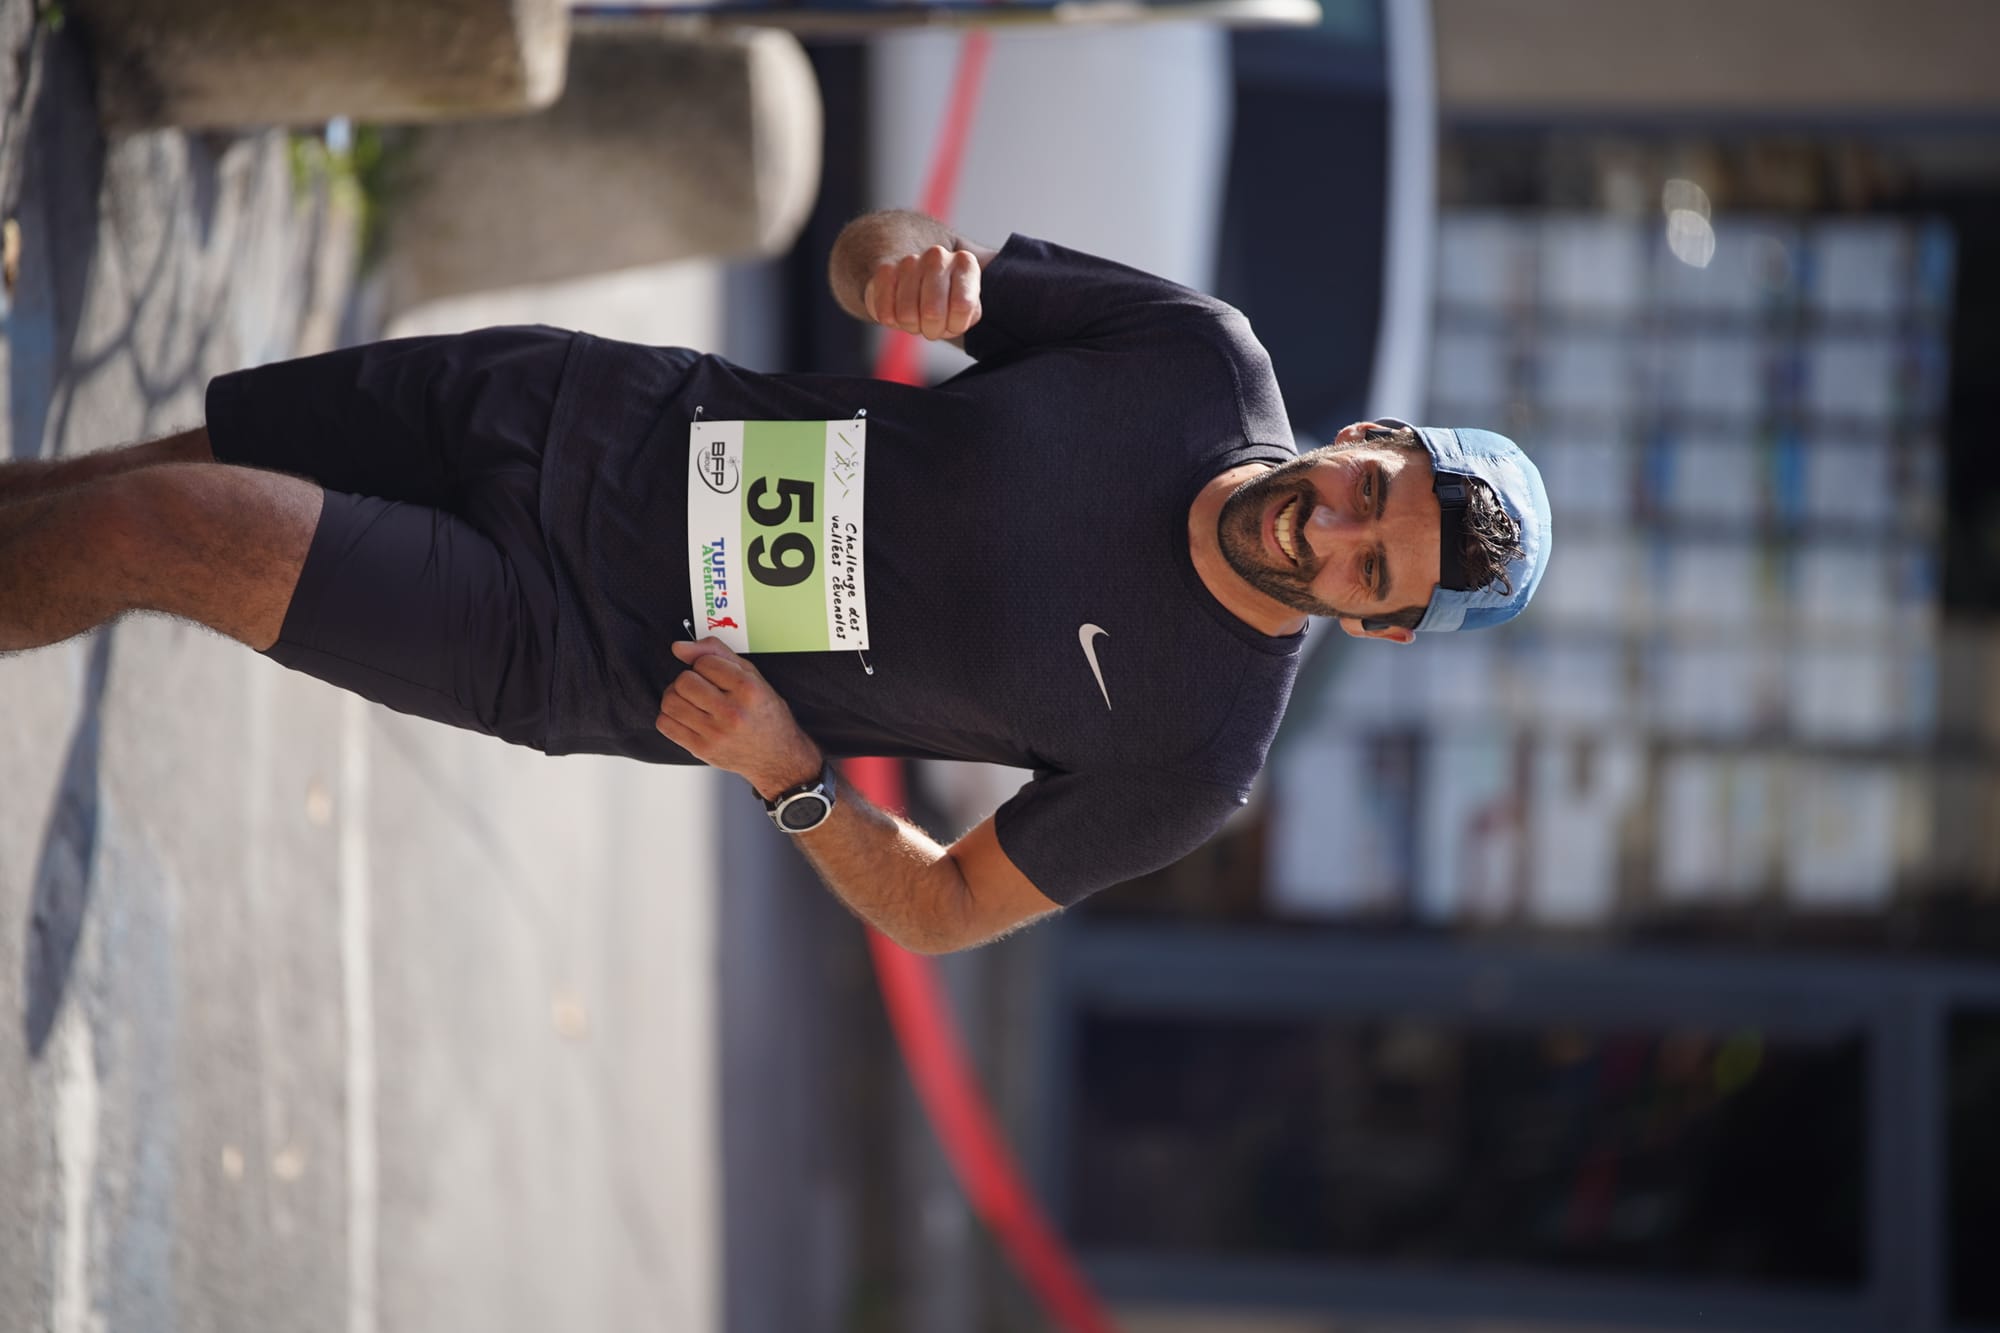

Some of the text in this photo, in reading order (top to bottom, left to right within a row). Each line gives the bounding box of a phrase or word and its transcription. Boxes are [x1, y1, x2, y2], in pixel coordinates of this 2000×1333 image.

[711, 441, 726, 486] BFP
[711, 537, 728, 609] TUFF'S
[747, 476, 815, 587] 59
[702, 545, 716, 617] Aventure
[832, 515, 846, 640] vallées cévenoles
[843, 523, 859, 631] Challenge des
